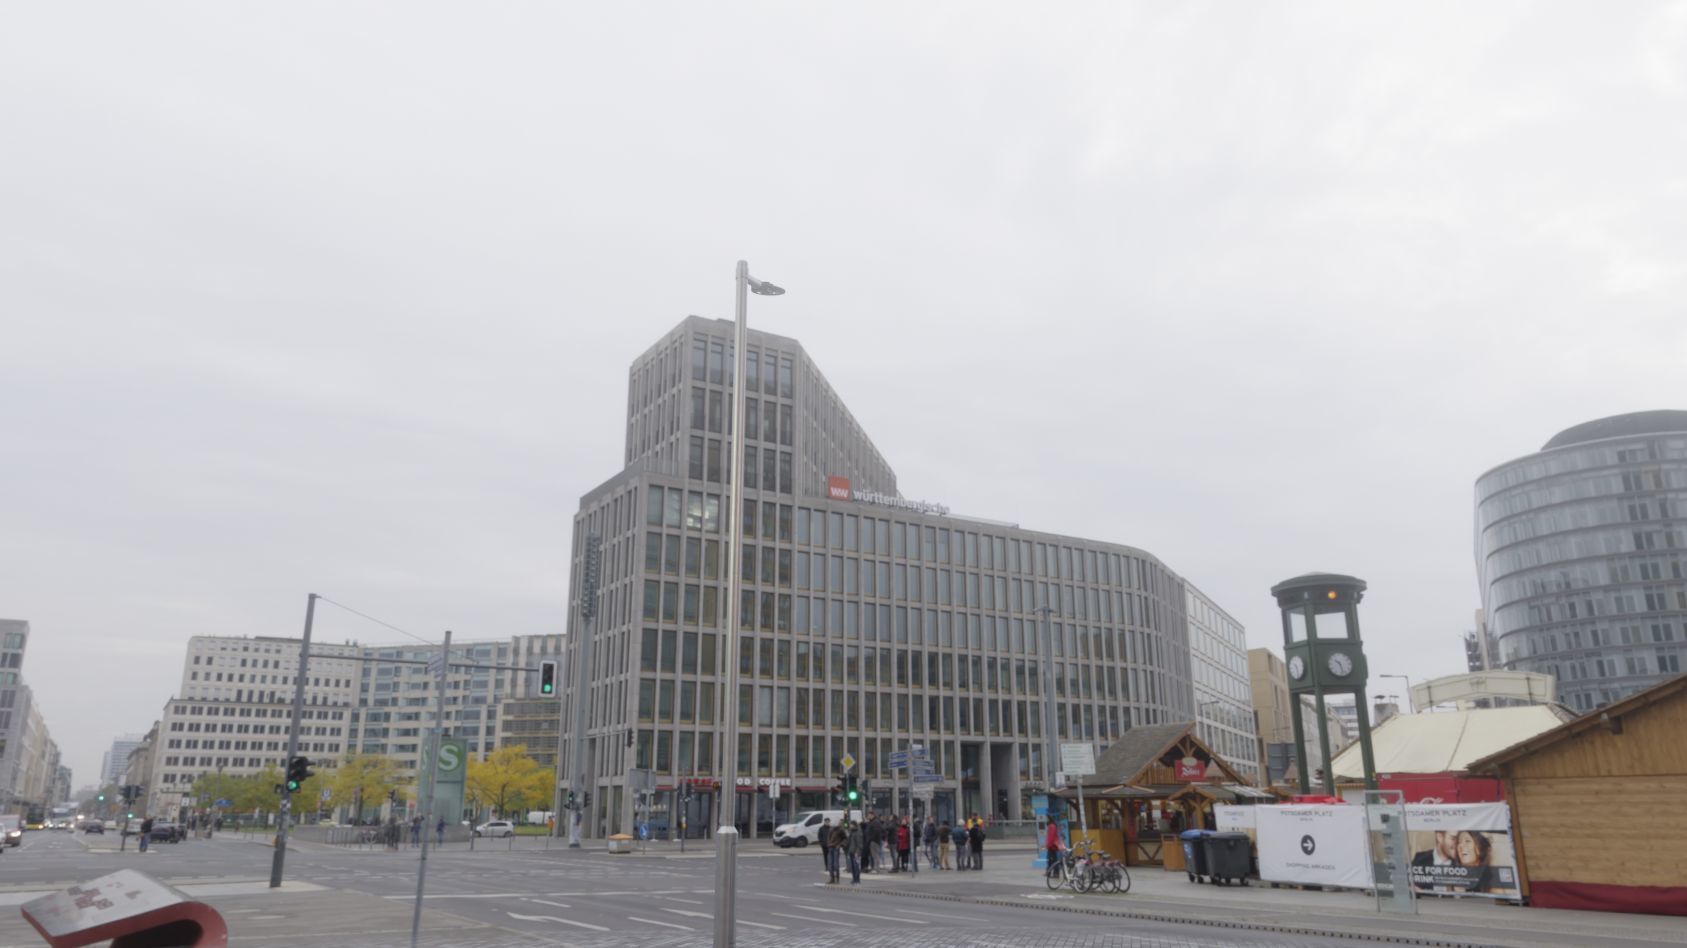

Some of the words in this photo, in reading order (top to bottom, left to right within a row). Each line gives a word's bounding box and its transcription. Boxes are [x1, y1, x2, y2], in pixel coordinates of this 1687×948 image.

[853, 488, 951, 515] württembergische
[439, 744, 459, 771] S
[759, 778, 791, 786] COFFEE
[1397, 809, 1440, 817] PTSDAMER
[1442, 809, 1467, 817] PLATZ
[1425, 866, 1442, 875] FOR
[1443, 867, 1468, 876] FOOD
